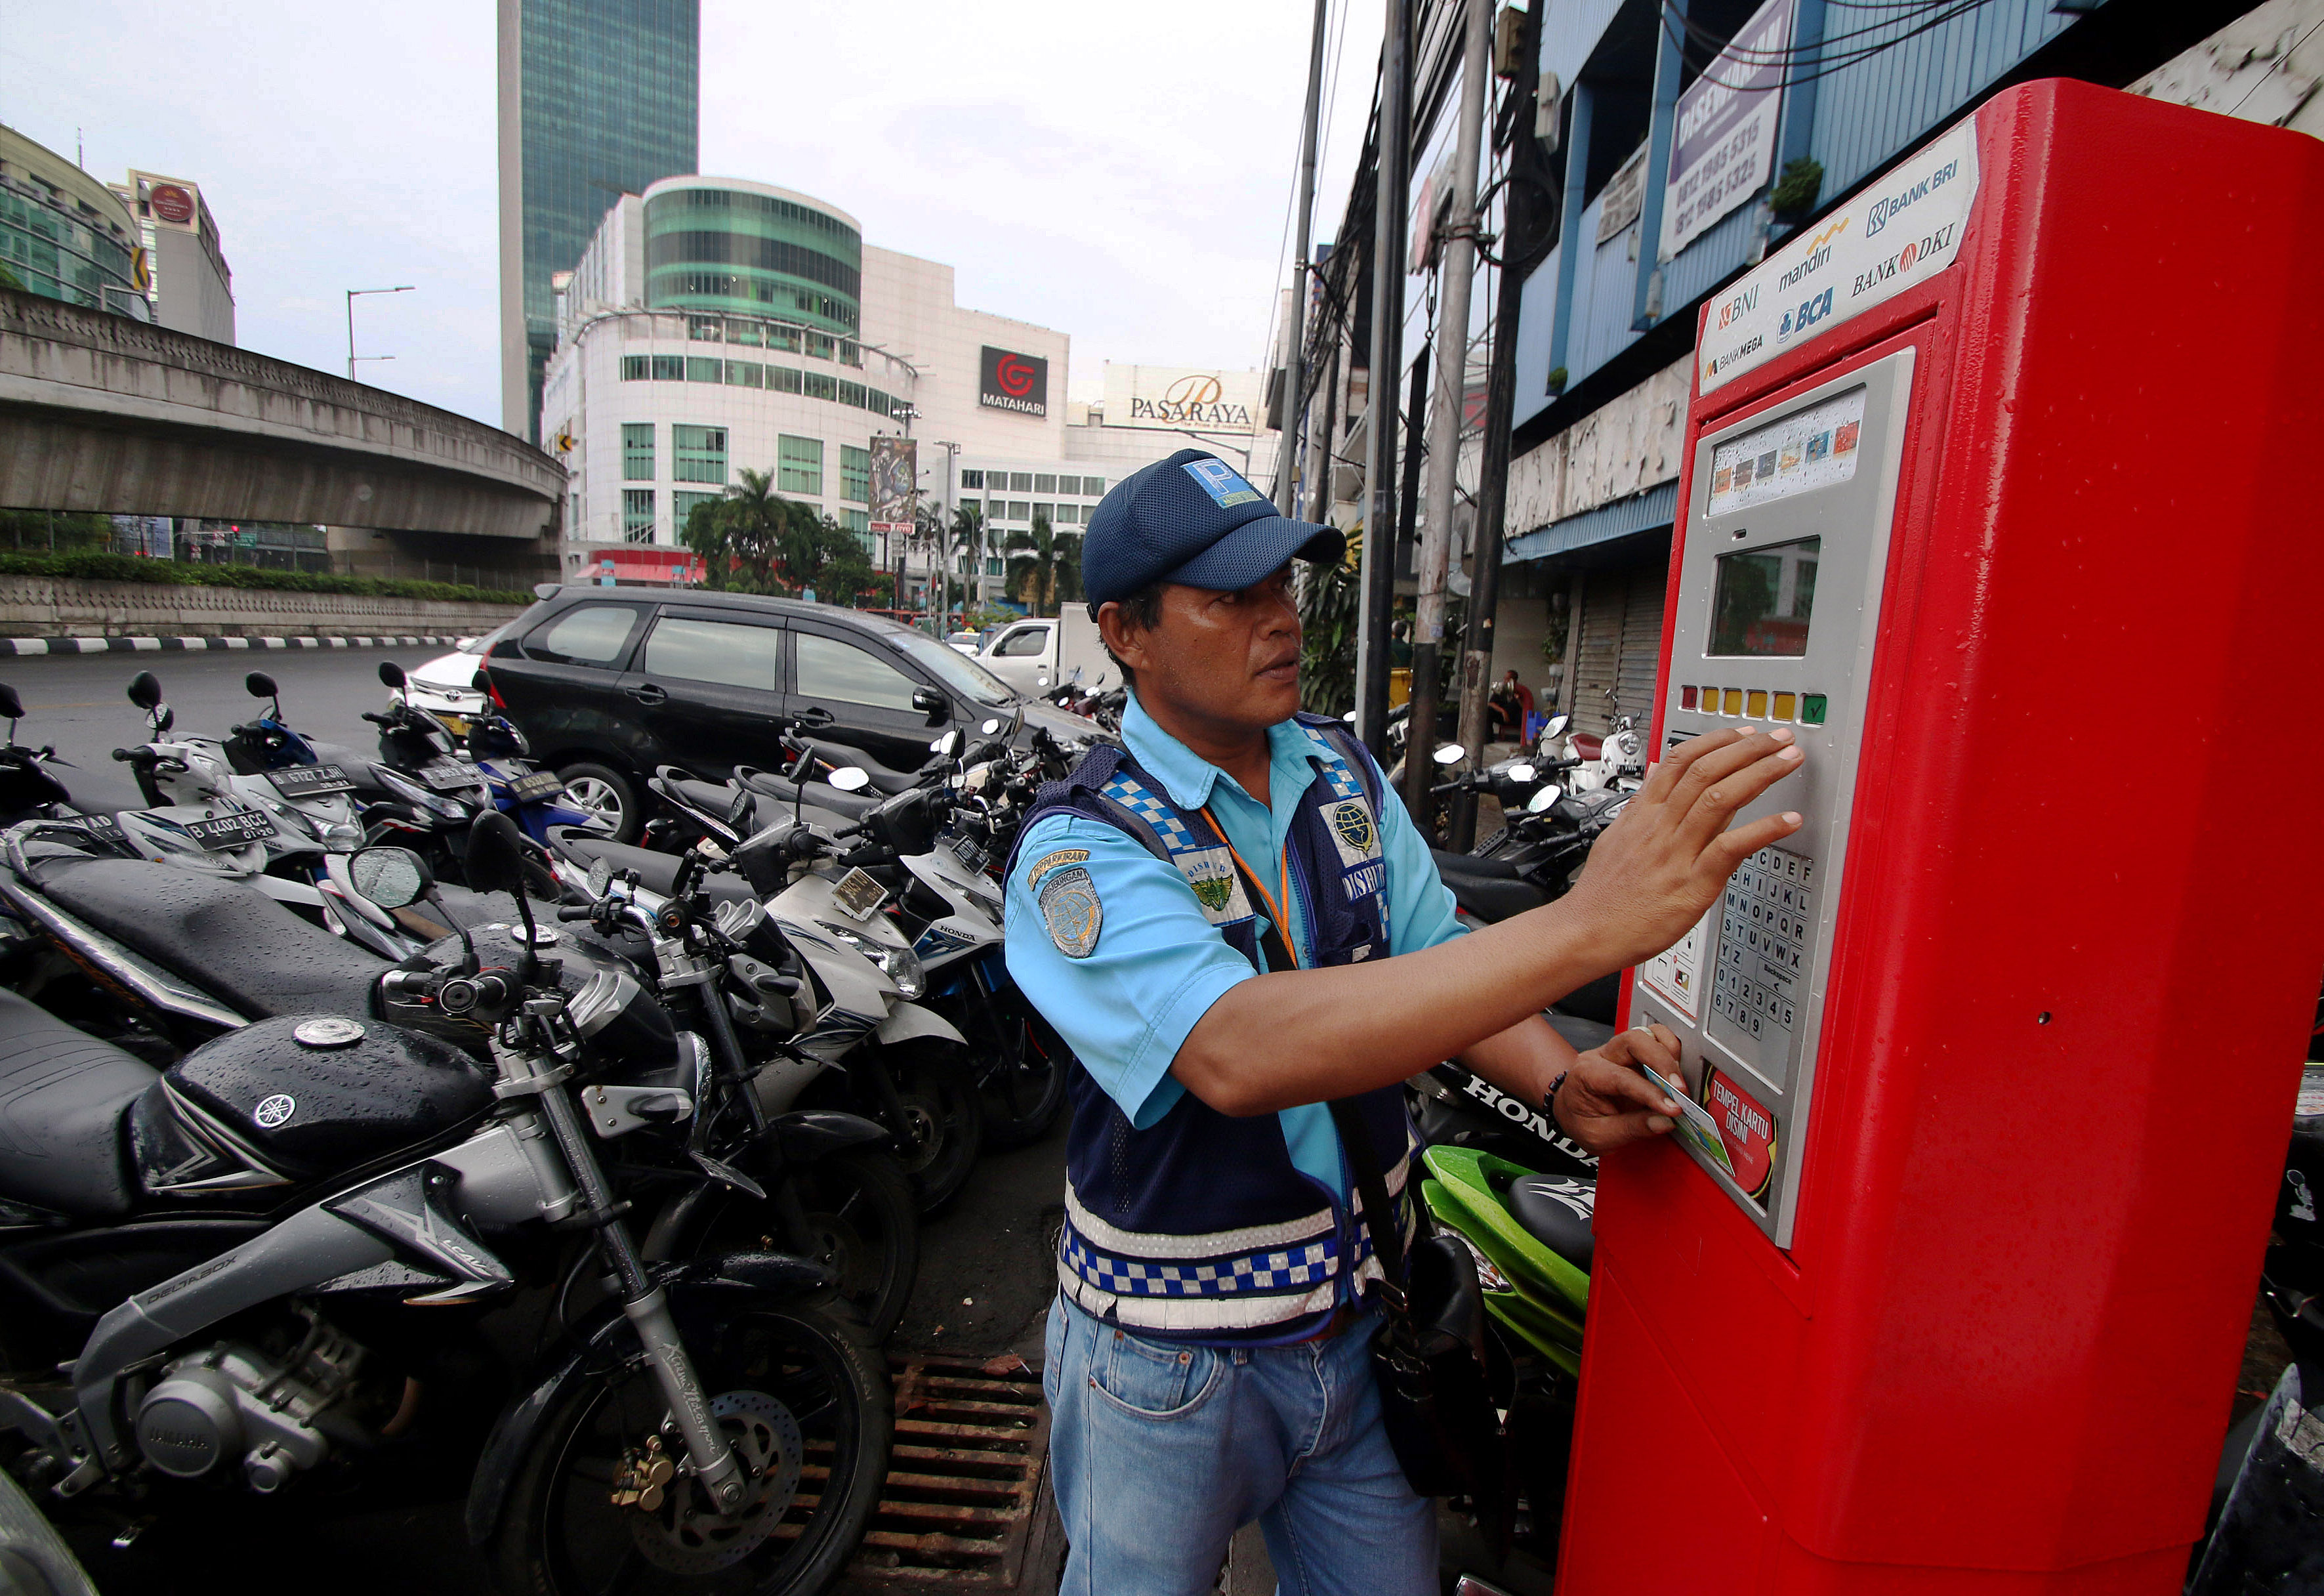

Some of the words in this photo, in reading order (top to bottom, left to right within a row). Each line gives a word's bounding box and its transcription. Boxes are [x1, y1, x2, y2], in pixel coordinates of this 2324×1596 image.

[1889, 176, 1930, 218] BANK
[1932, 159, 1958, 190] BRI
[1779, 244, 1831, 293] mandiri
[1851, 253, 1900, 298] BANK
[1917, 222, 1955, 263] DKI
[1731, 283, 1760, 324] BNI
[1795, 286, 1833, 333] BCA
[982, 393, 1045, 415] MATAHARI
[1131, 398, 1251, 424] PASARAYA
[1193, 462, 1233, 495] P
[272, 774, 284, 785] B
[190, 826, 205, 839] B
[207, 819, 241, 834] 4402
[238, 814, 268, 828] BCC
[1342, 863, 1385, 901] DISHUB
[1760, 852, 1767, 864] C
[1774, 856, 1781, 870] D
[1788, 862, 1795, 875] E
[1804, 867, 1811, 880] F
[1743, 873, 1751, 886] H
[1758, 879, 1762, 891] I
[1770, 885, 1777, 897] J
[1783, 889, 1793, 904] K
[1800, 896, 1806, 911] L
[940, 925, 976, 941] HONDA
[1727, 893, 1735, 907] M
[1740, 898, 1747, 913] N
[1766, 912, 1773, 923] P
[1781, 918, 1788, 933] Q
[1795, 924, 1803, 940] R
[1722, 943, 1728, 956] Y
[1733, 950, 1740, 964] Z
[1725, 919, 1731, 931] S
[1738, 925, 1743, 937] T
[1750, 931, 1756, 944] U
[1764, 937, 1770, 952] V
[1776, 944, 1786, 960] W
[1791, 953, 1800, 968] X
[1764, 964, 1792, 985] Backspace
[1716, 994, 1721, 1006] 6
[1728, 1001, 1733, 1014] 7
[1740, 1011, 1746, 1023] 8
[1753, 1019, 1759, 1032] 9
[1732, 977, 1735, 989] 1
[1743, 984, 1749, 998] 2
[1756, 992, 1762, 1005] 3
[1770, 1001, 1776, 1015] 4
[1785, 1009, 1791, 1024] 5
[1712, 1080, 1740, 1116] TEMPEL
[1741, 1102, 1769, 1140] KARTU
[1726, 1113, 1749, 1145] DISINI
[147, 1253, 239, 1307] DELTABOX
